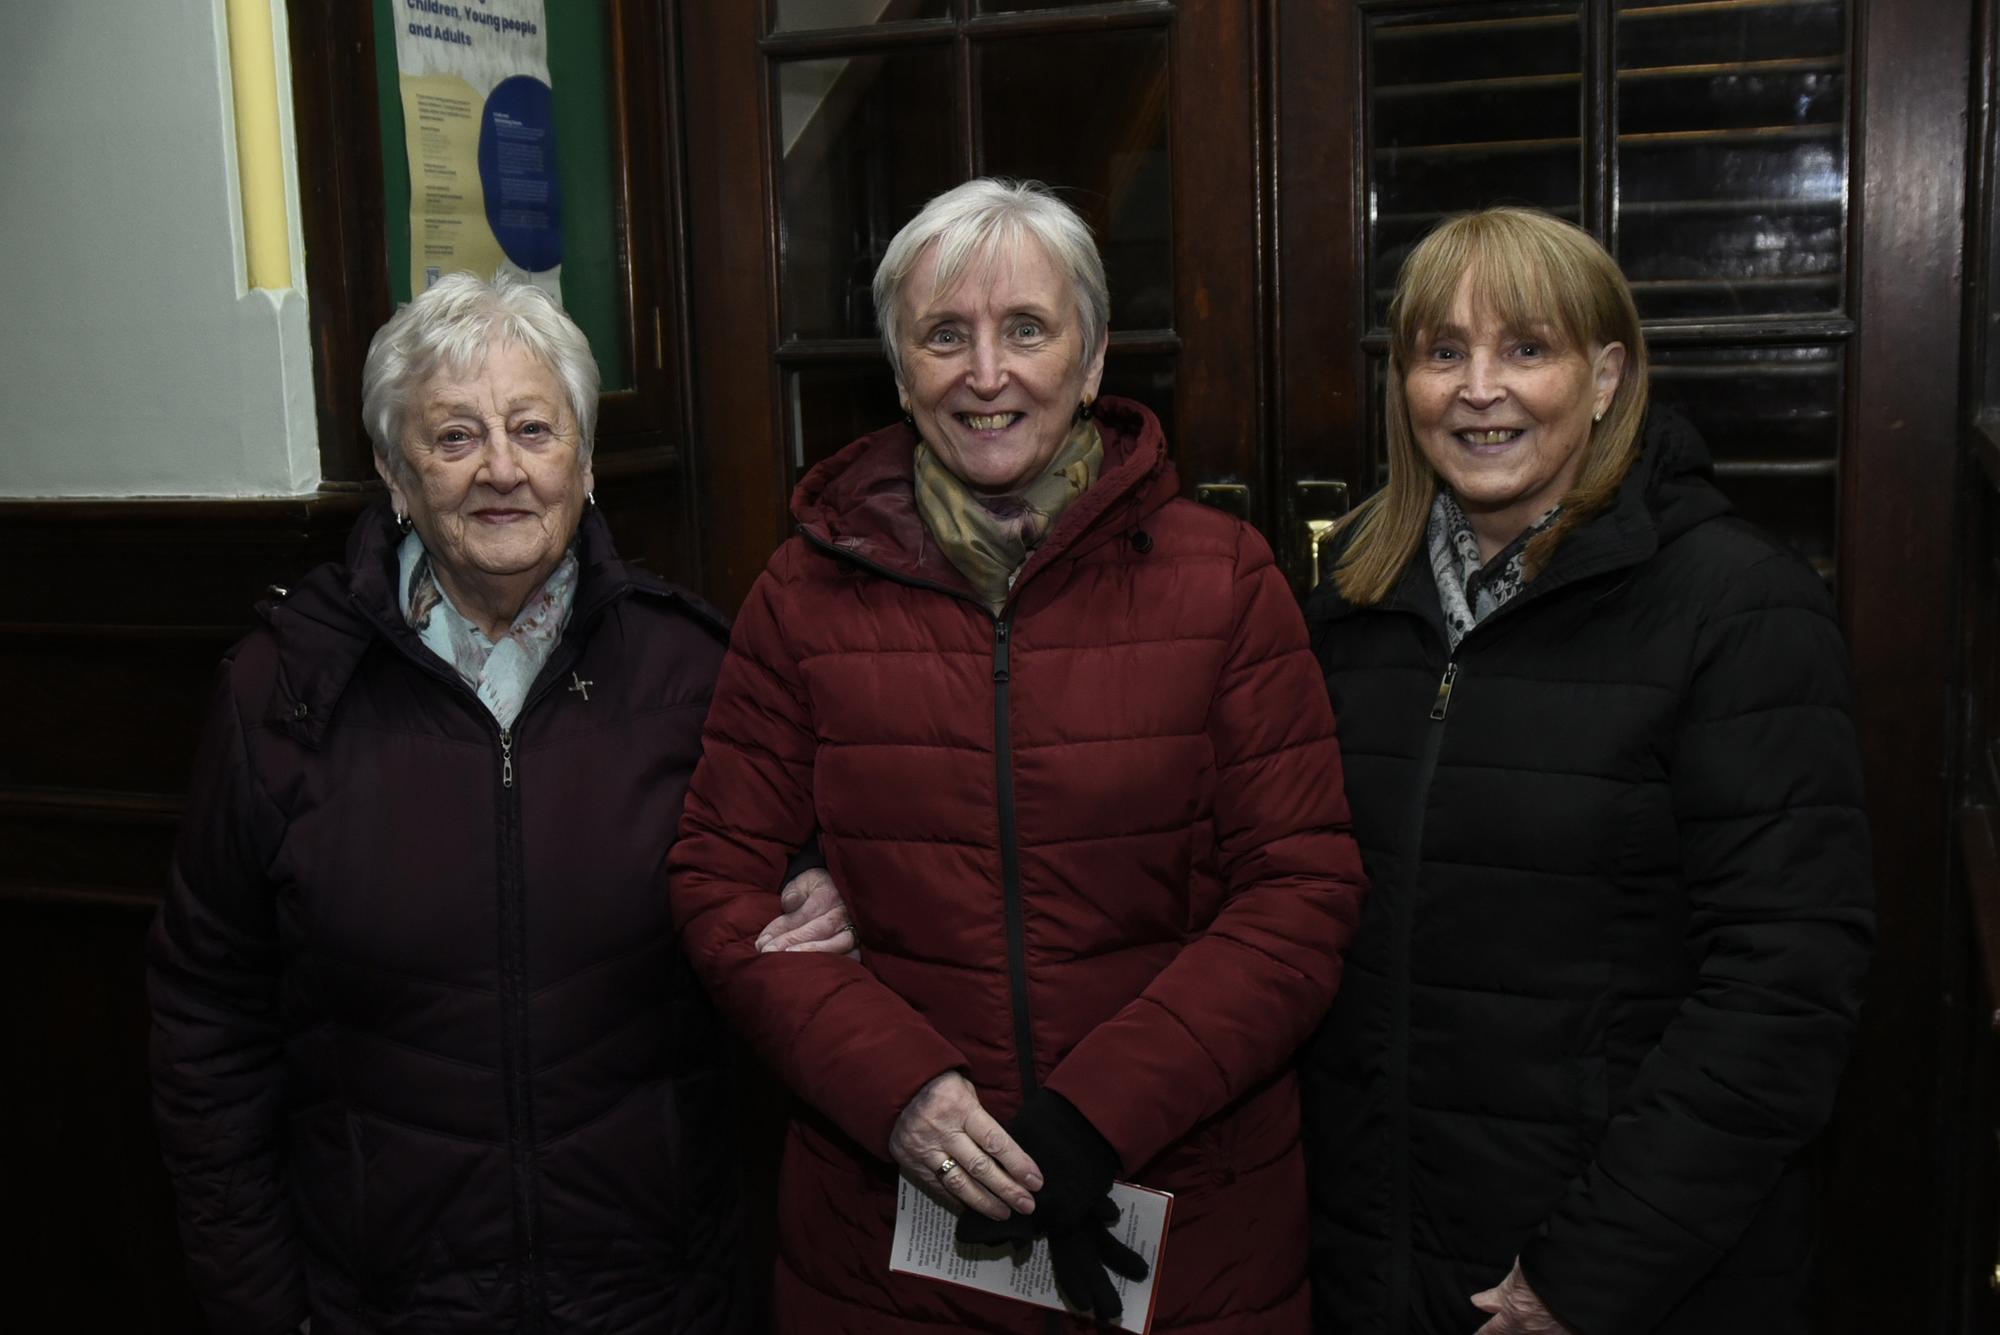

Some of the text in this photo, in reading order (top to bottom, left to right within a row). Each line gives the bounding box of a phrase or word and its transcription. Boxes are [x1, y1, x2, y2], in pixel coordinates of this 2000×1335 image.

[409, 22, 472, 46] and Adults
[464, 7, 500, 31] Young
[502, 19, 537, 36] people
